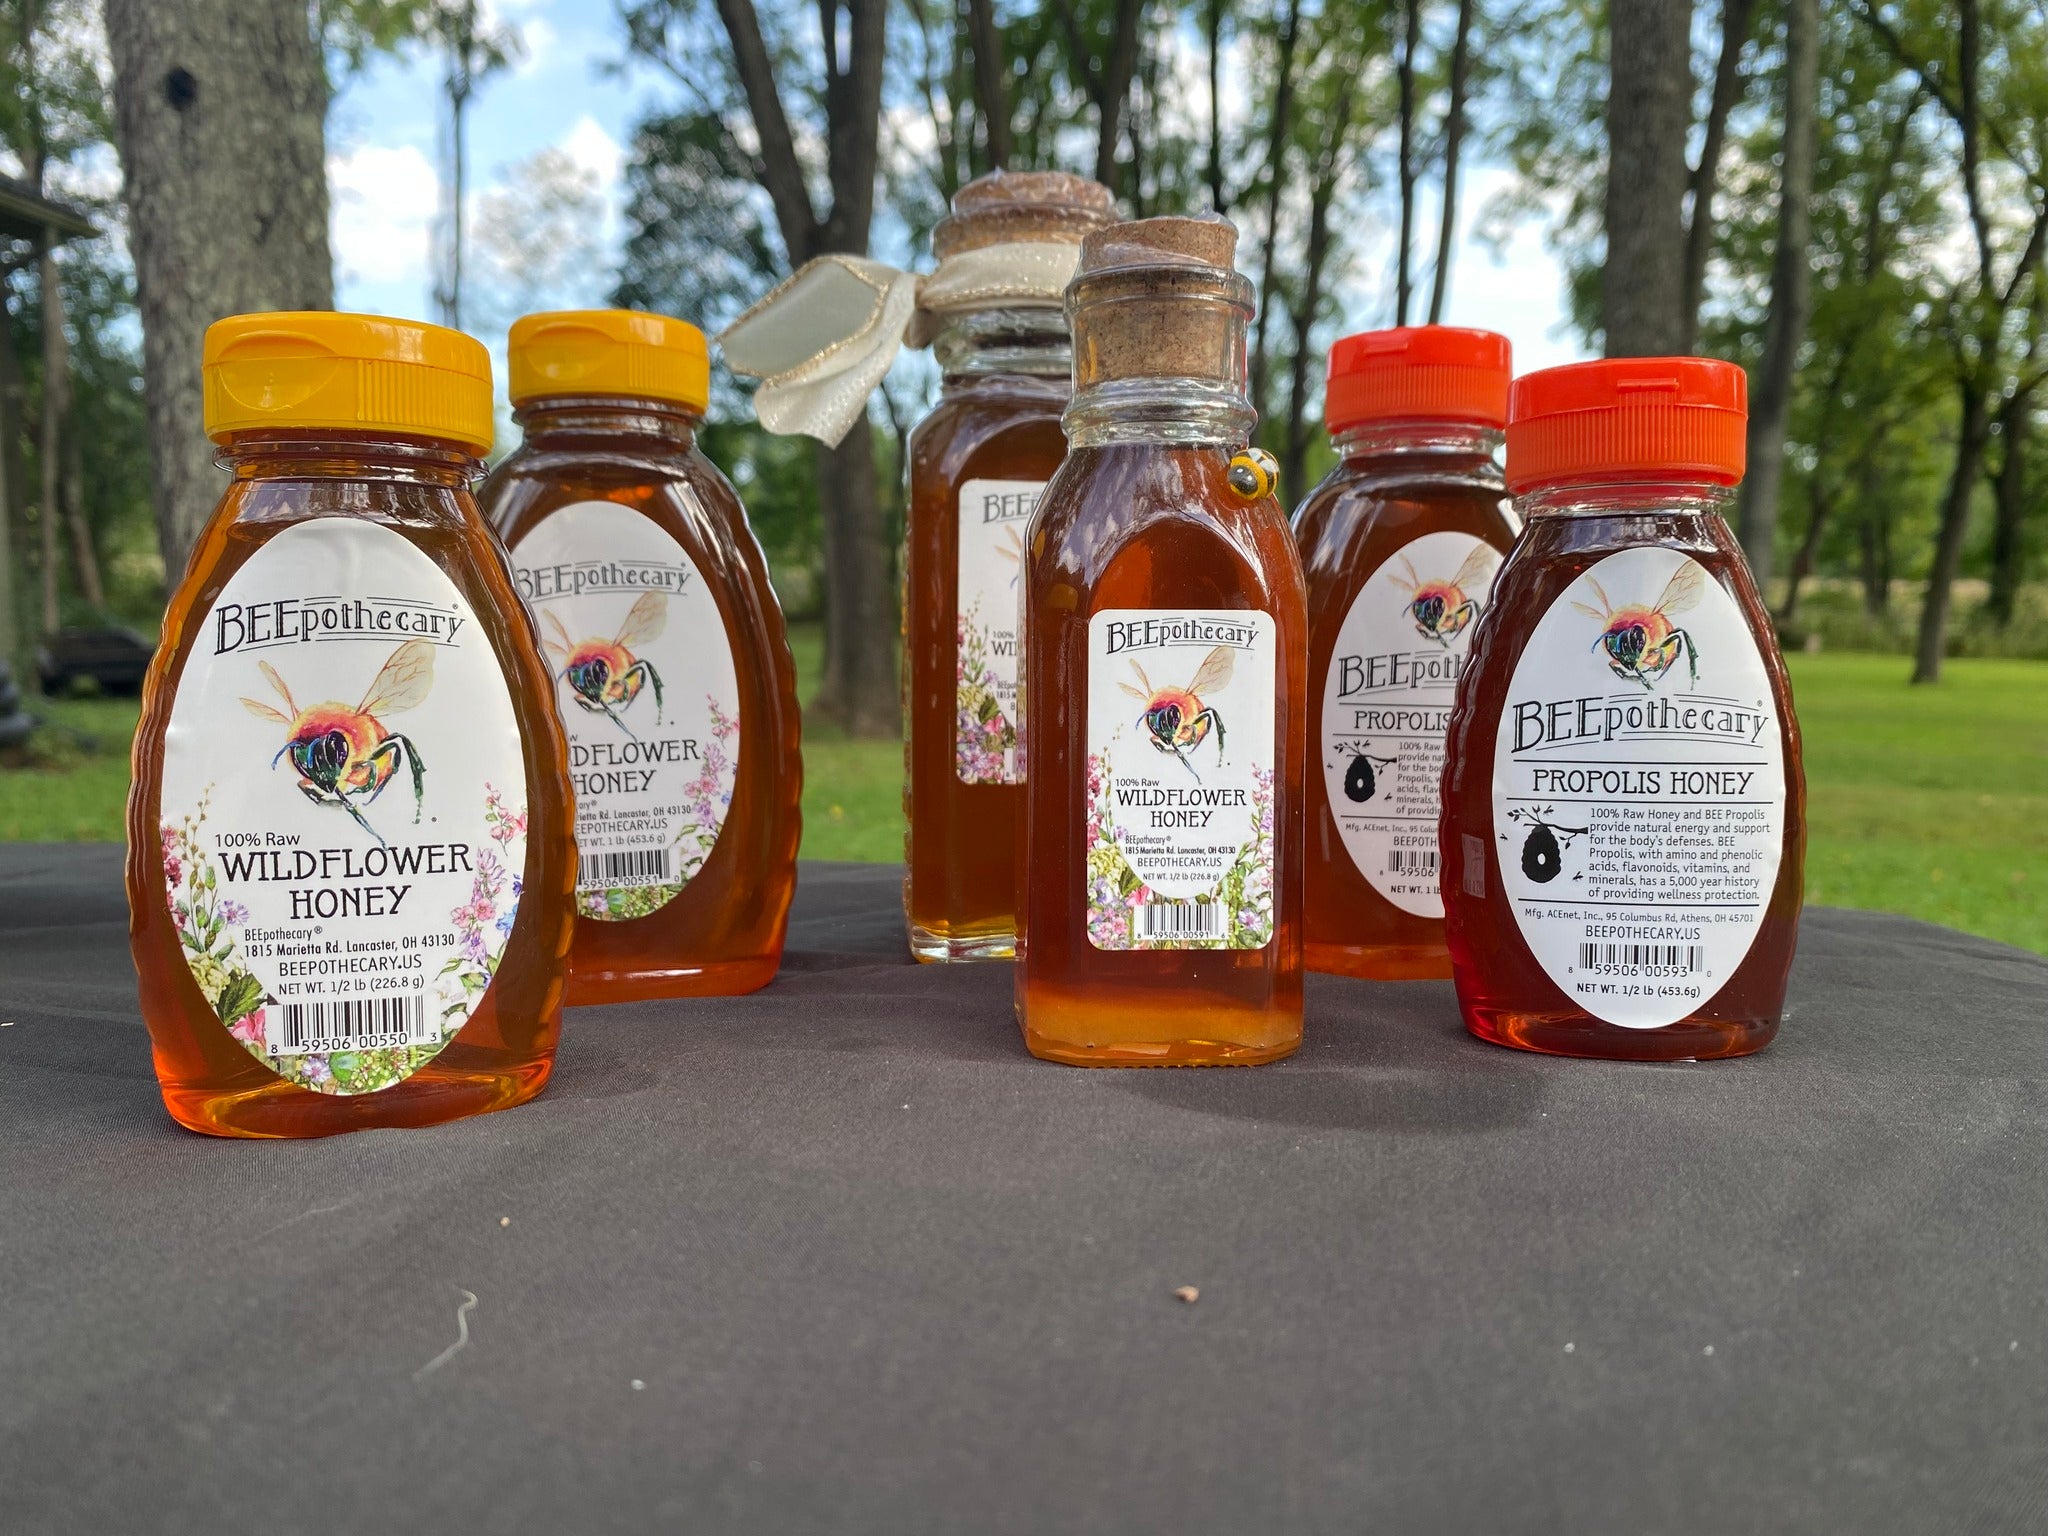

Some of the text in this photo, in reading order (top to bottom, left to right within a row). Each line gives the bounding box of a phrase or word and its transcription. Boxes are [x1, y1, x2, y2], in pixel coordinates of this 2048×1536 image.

[1400, 741, 1440, 750] 100% Raw
[1398, 752, 1430, 761] provide
[1413, 763, 1426, 771] the
[1533, 769, 1754, 794] PROPOLIS HONEY
[1116, 789, 1247, 806] WILDFLOWER
[600, 811, 611, 819] Rd.
[654, 807, 664, 816] OH
[667, 805, 691, 815] 43130
[1396, 805, 1405, 813] of
[1591, 808, 1765, 822] 100% Raw Honey and BEE Propolis
[1151, 810, 1213, 827] HONEY
[1590, 822, 1770, 835] provide natural energy and support
[215, 832, 300, 848] 100% Raw
[591, 838, 605, 846] WT.
[608, 837, 612, 845] 1
[616, 836, 624, 844] lb
[627, 834, 654, 846] (453.6
[657, 833, 666, 844] g)
[1393, 836, 1437, 846] BEEPOTH
[1589, 835, 1735, 846] for the body's defenses. BEE
[1140, 846, 1164, 854] Marietta
[1208, 846, 1217, 854] OH
[1218, 846, 1235, 854] 43130
[1589, 849, 1763, 862] Propolis, with amino and phenolic
[218, 844, 473, 882] WILDFLOWER
[1137, 858, 1222, 866] BEEPOTHECARY.US
[1589, 862, 1750, 874] acids, flavonoids, vitamins, and
[1190, 873, 1211, 881] (226.8
[1213, 873, 1219, 881] g)
[1401, 867, 1434, 876] 59506
[583, 878, 618, 889] 59506
[624, 876, 658, 886] 00551
[1588, 875, 1636, 886] minerals,
[1640, 877, 1657, 885] has
[1669, 877, 1697, 887] 5,000
[1700, 879, 1721, 888] year
[1725, 877, 1759, 888] history
[1391, 885, 1406, 893] NET
[1588, 888, 1759, 901] of providing wellness protection.
[289, 885, 412, 920] HONEY
[1525, 908, 1544, 919] Mfg.
[1547, 910, 1580, 921] ACEnet,
[1606, 912, 1617, 921] 95
[1620, 913, 1662, 922] Columbus
[1665, 914, 1677, 923] Rd,
[1681, 914, 1712, 923] Athens,
[1714, 914, 1726, 922] OH
[1729, 914, 1753, 922] 45701
[1586, 925, 1700, 940] BEEPOTHECARY.US
[245, 934, 455, 958] 1815 Marietta Rd. Lancaster, OH 43130
[279, 954, 422, 977] BEEPOTHECARY.US
[1595, 964, 1638, 977] 59506
[1645, 965, 1688, 977] 00593
[279, 975, 424, 995] NET WT. 1/2 lb (226.8 g)
[1577, 983, 1701, 998] NET WT. 1/2 lb (453.6g)
[271, 1033, 437, 1053] 8 59506 00550 3
